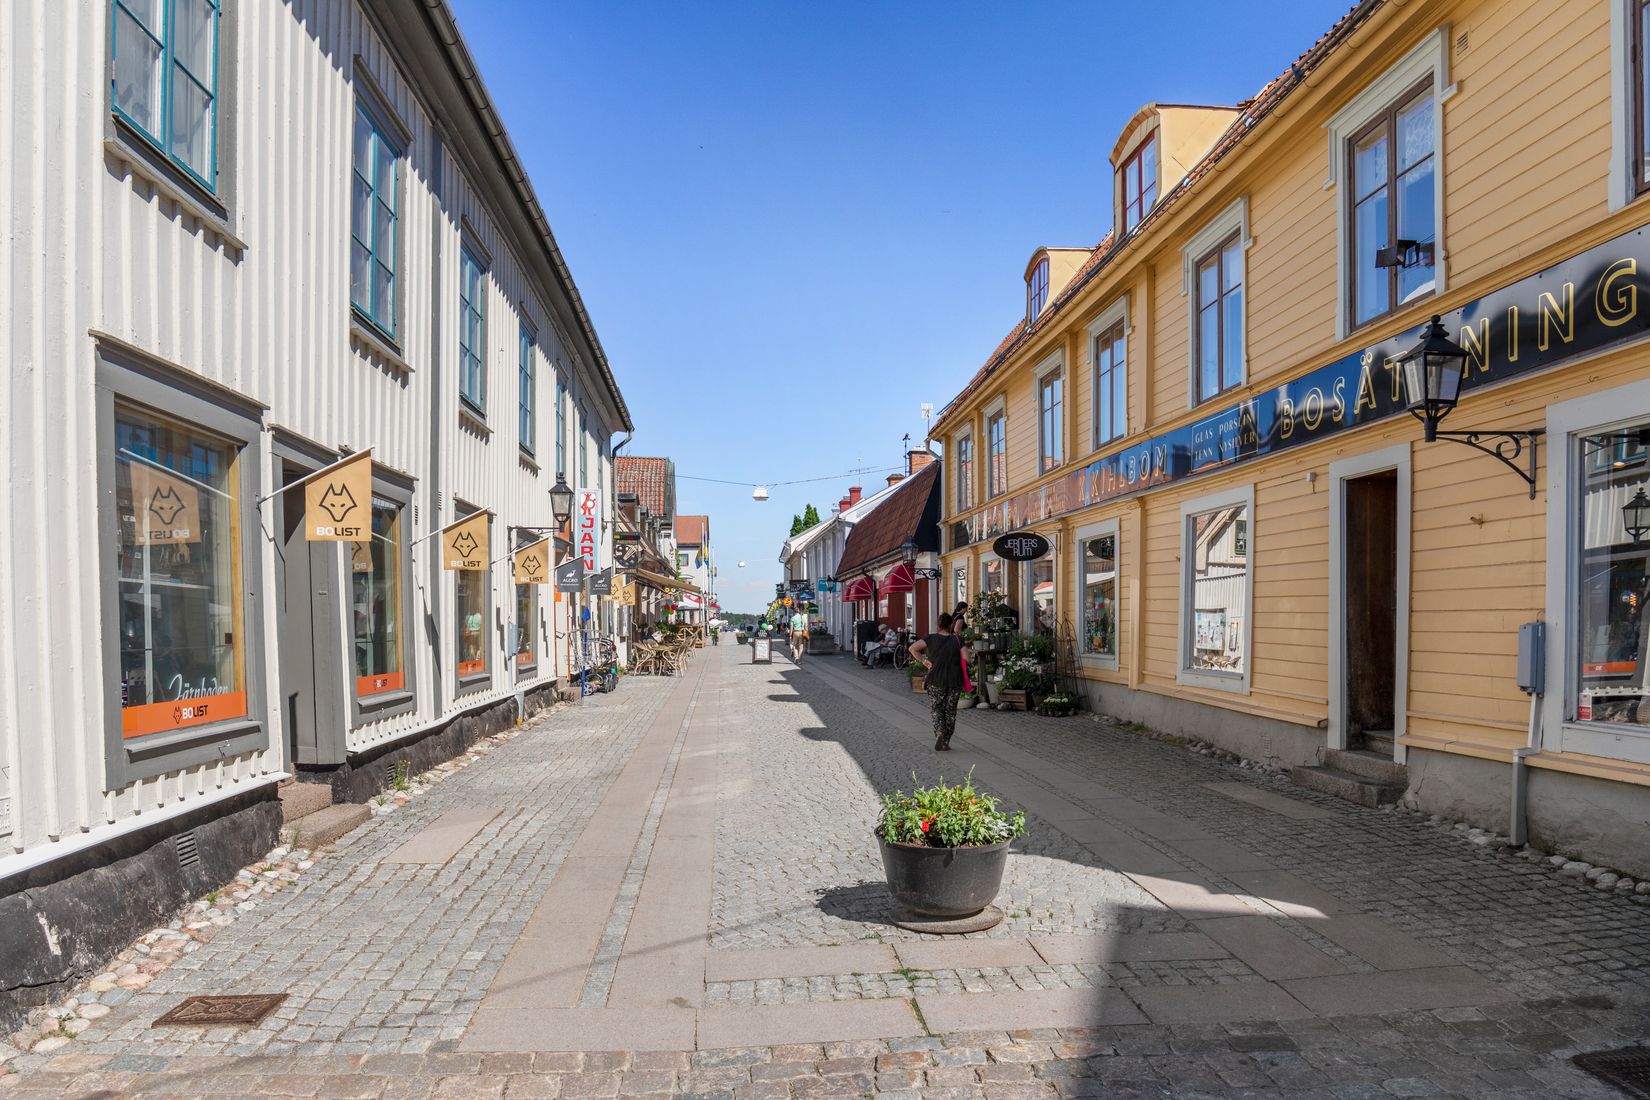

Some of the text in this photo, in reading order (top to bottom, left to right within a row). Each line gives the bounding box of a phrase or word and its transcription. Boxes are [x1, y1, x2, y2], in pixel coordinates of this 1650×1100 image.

[1280, 257, 1637, 440] BOSÄTNING
[1195, 428, 1213, 443] GLAS
[1195, 447, 1213, 462] TENN
[316, 526, 361, 537] BOLIST
[580, 517, 595, 571] JÄRN
[450, 560, 482, 568] BOLIST
[182, 704, 209, 719] BOLIST
